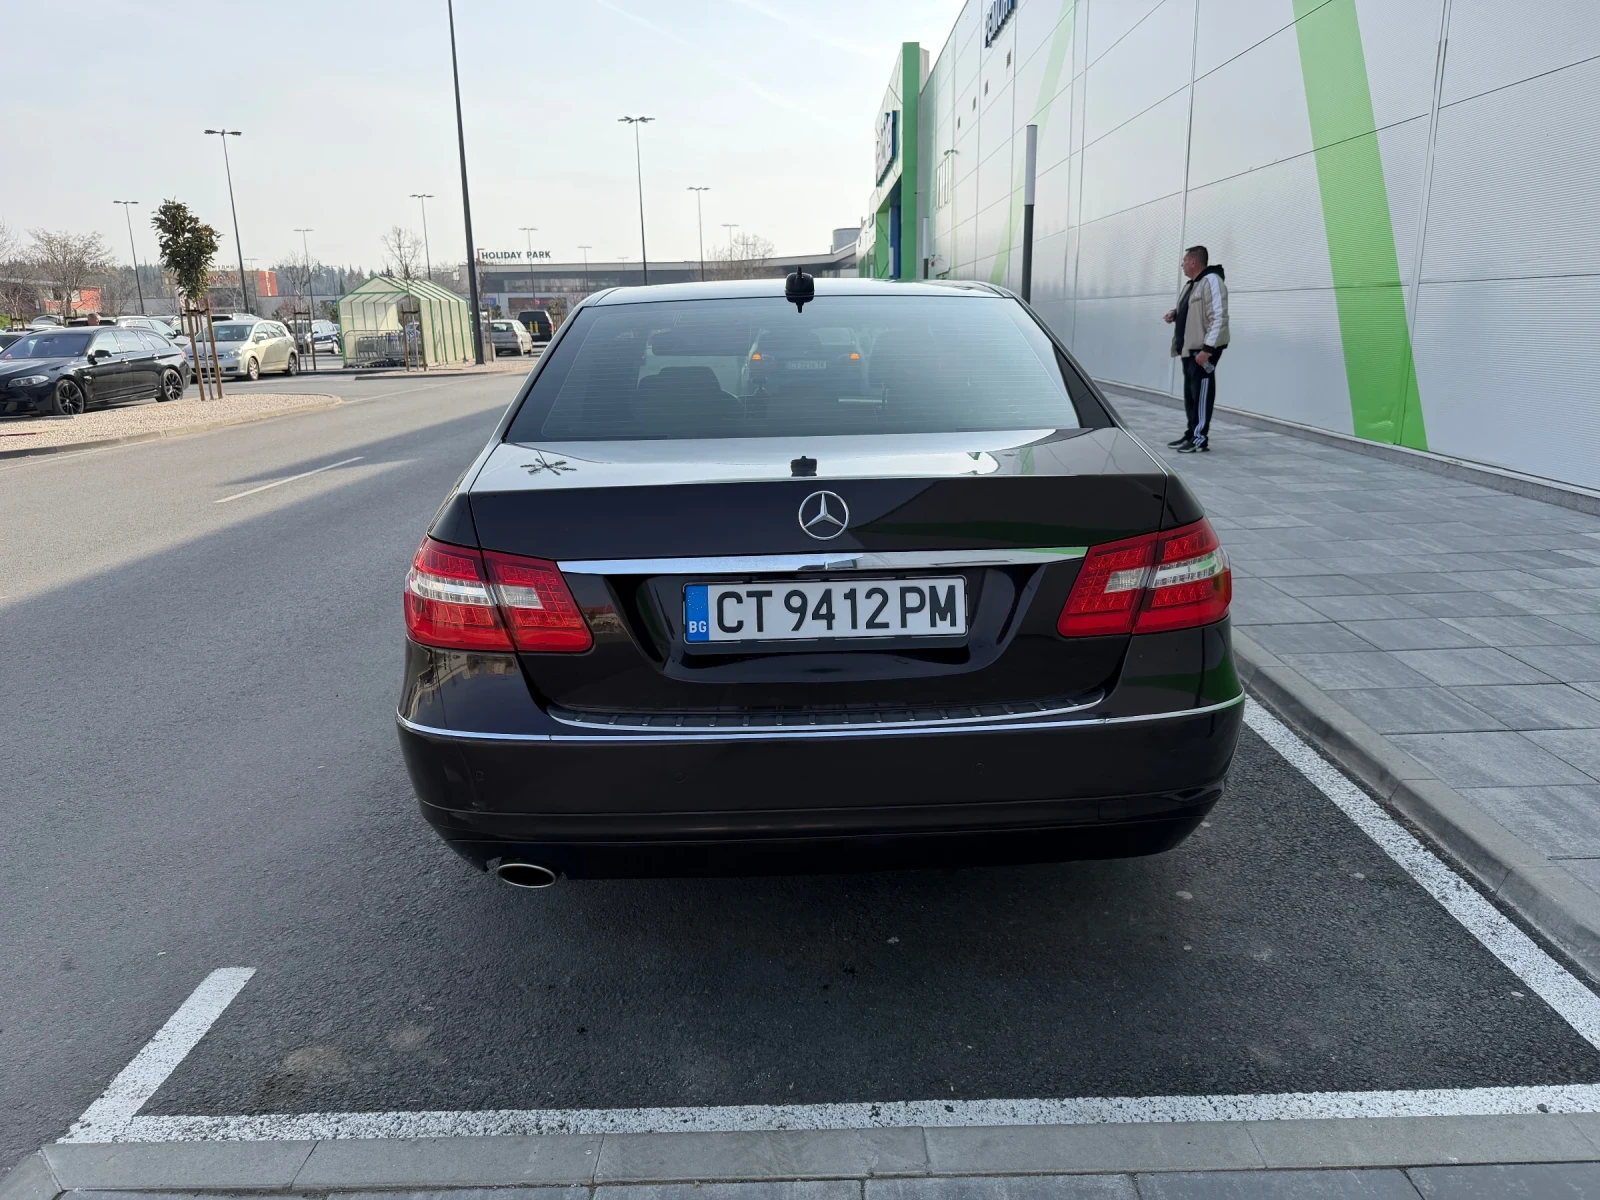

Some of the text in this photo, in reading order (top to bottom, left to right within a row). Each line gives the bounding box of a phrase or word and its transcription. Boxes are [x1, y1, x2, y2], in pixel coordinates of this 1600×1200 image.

[481, 251, 551, 259] HOLIDAY PARK
[716, 584, 957, 633] CT 9412 PM
[688, 620, 707, 633] BG
